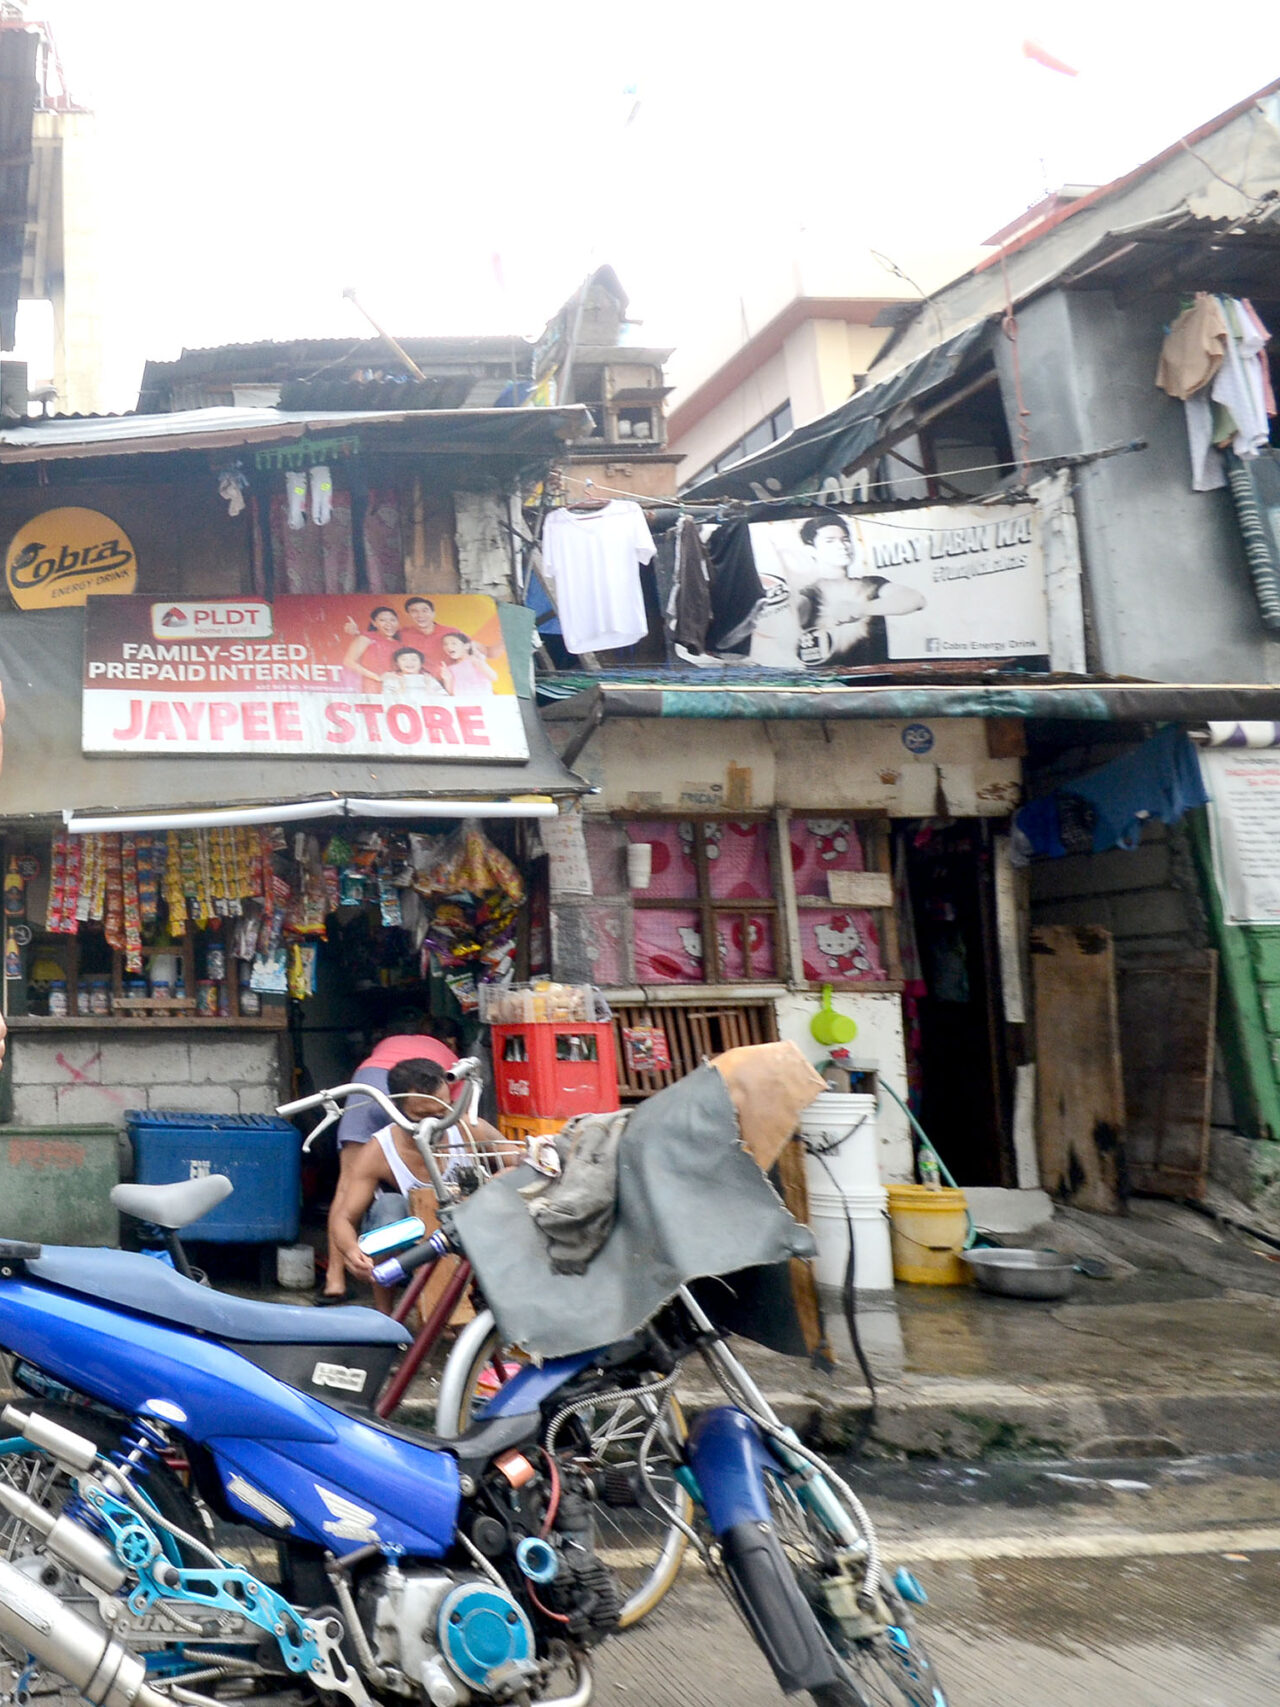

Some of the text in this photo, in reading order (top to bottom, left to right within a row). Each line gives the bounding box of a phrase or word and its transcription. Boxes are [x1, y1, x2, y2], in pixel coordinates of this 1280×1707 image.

[11, 539, 132, 589] Cobra
[194, 609, 260, 625] PLDT
[122, 643, 308, 662] FAMILY-SIZED
[88, 661, 344, 682] PREPAID INTERNET
[113, 700, 491, 746] JAYPEE STORE
